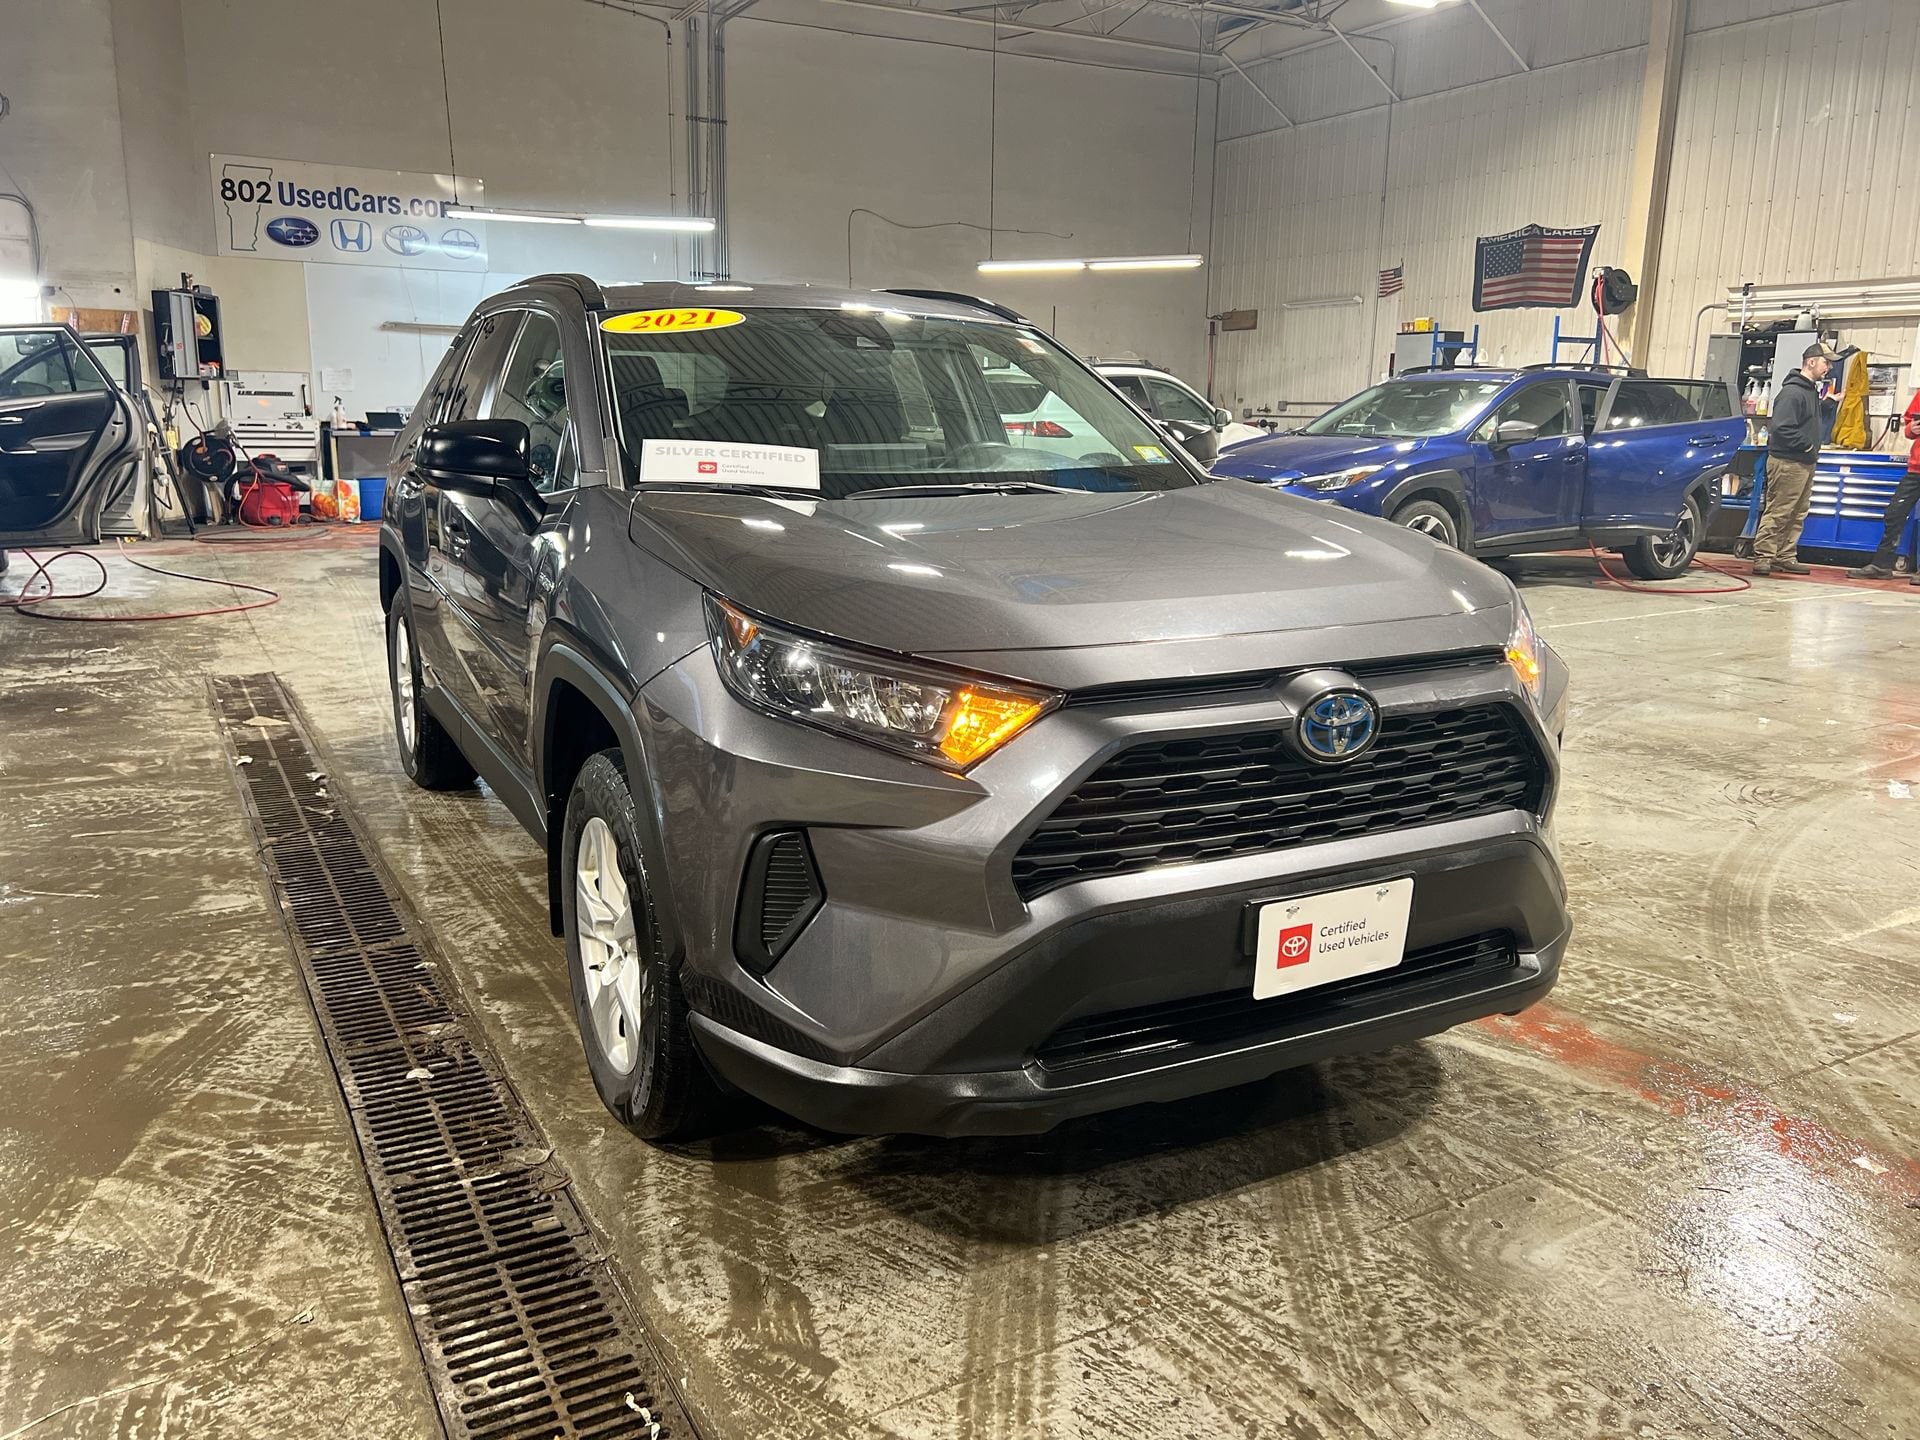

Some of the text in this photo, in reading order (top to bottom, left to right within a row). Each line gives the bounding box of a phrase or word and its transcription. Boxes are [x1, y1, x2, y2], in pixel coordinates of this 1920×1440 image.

[221, 178, 273, 205] 802
[632, 311, 717, 330] 2021
[655, 446, 807, 463] SILVER CERTIFIED
[1320, 918, 1366, 938] Certified
[1318, 930, 1390, 954] Used Vehicles
